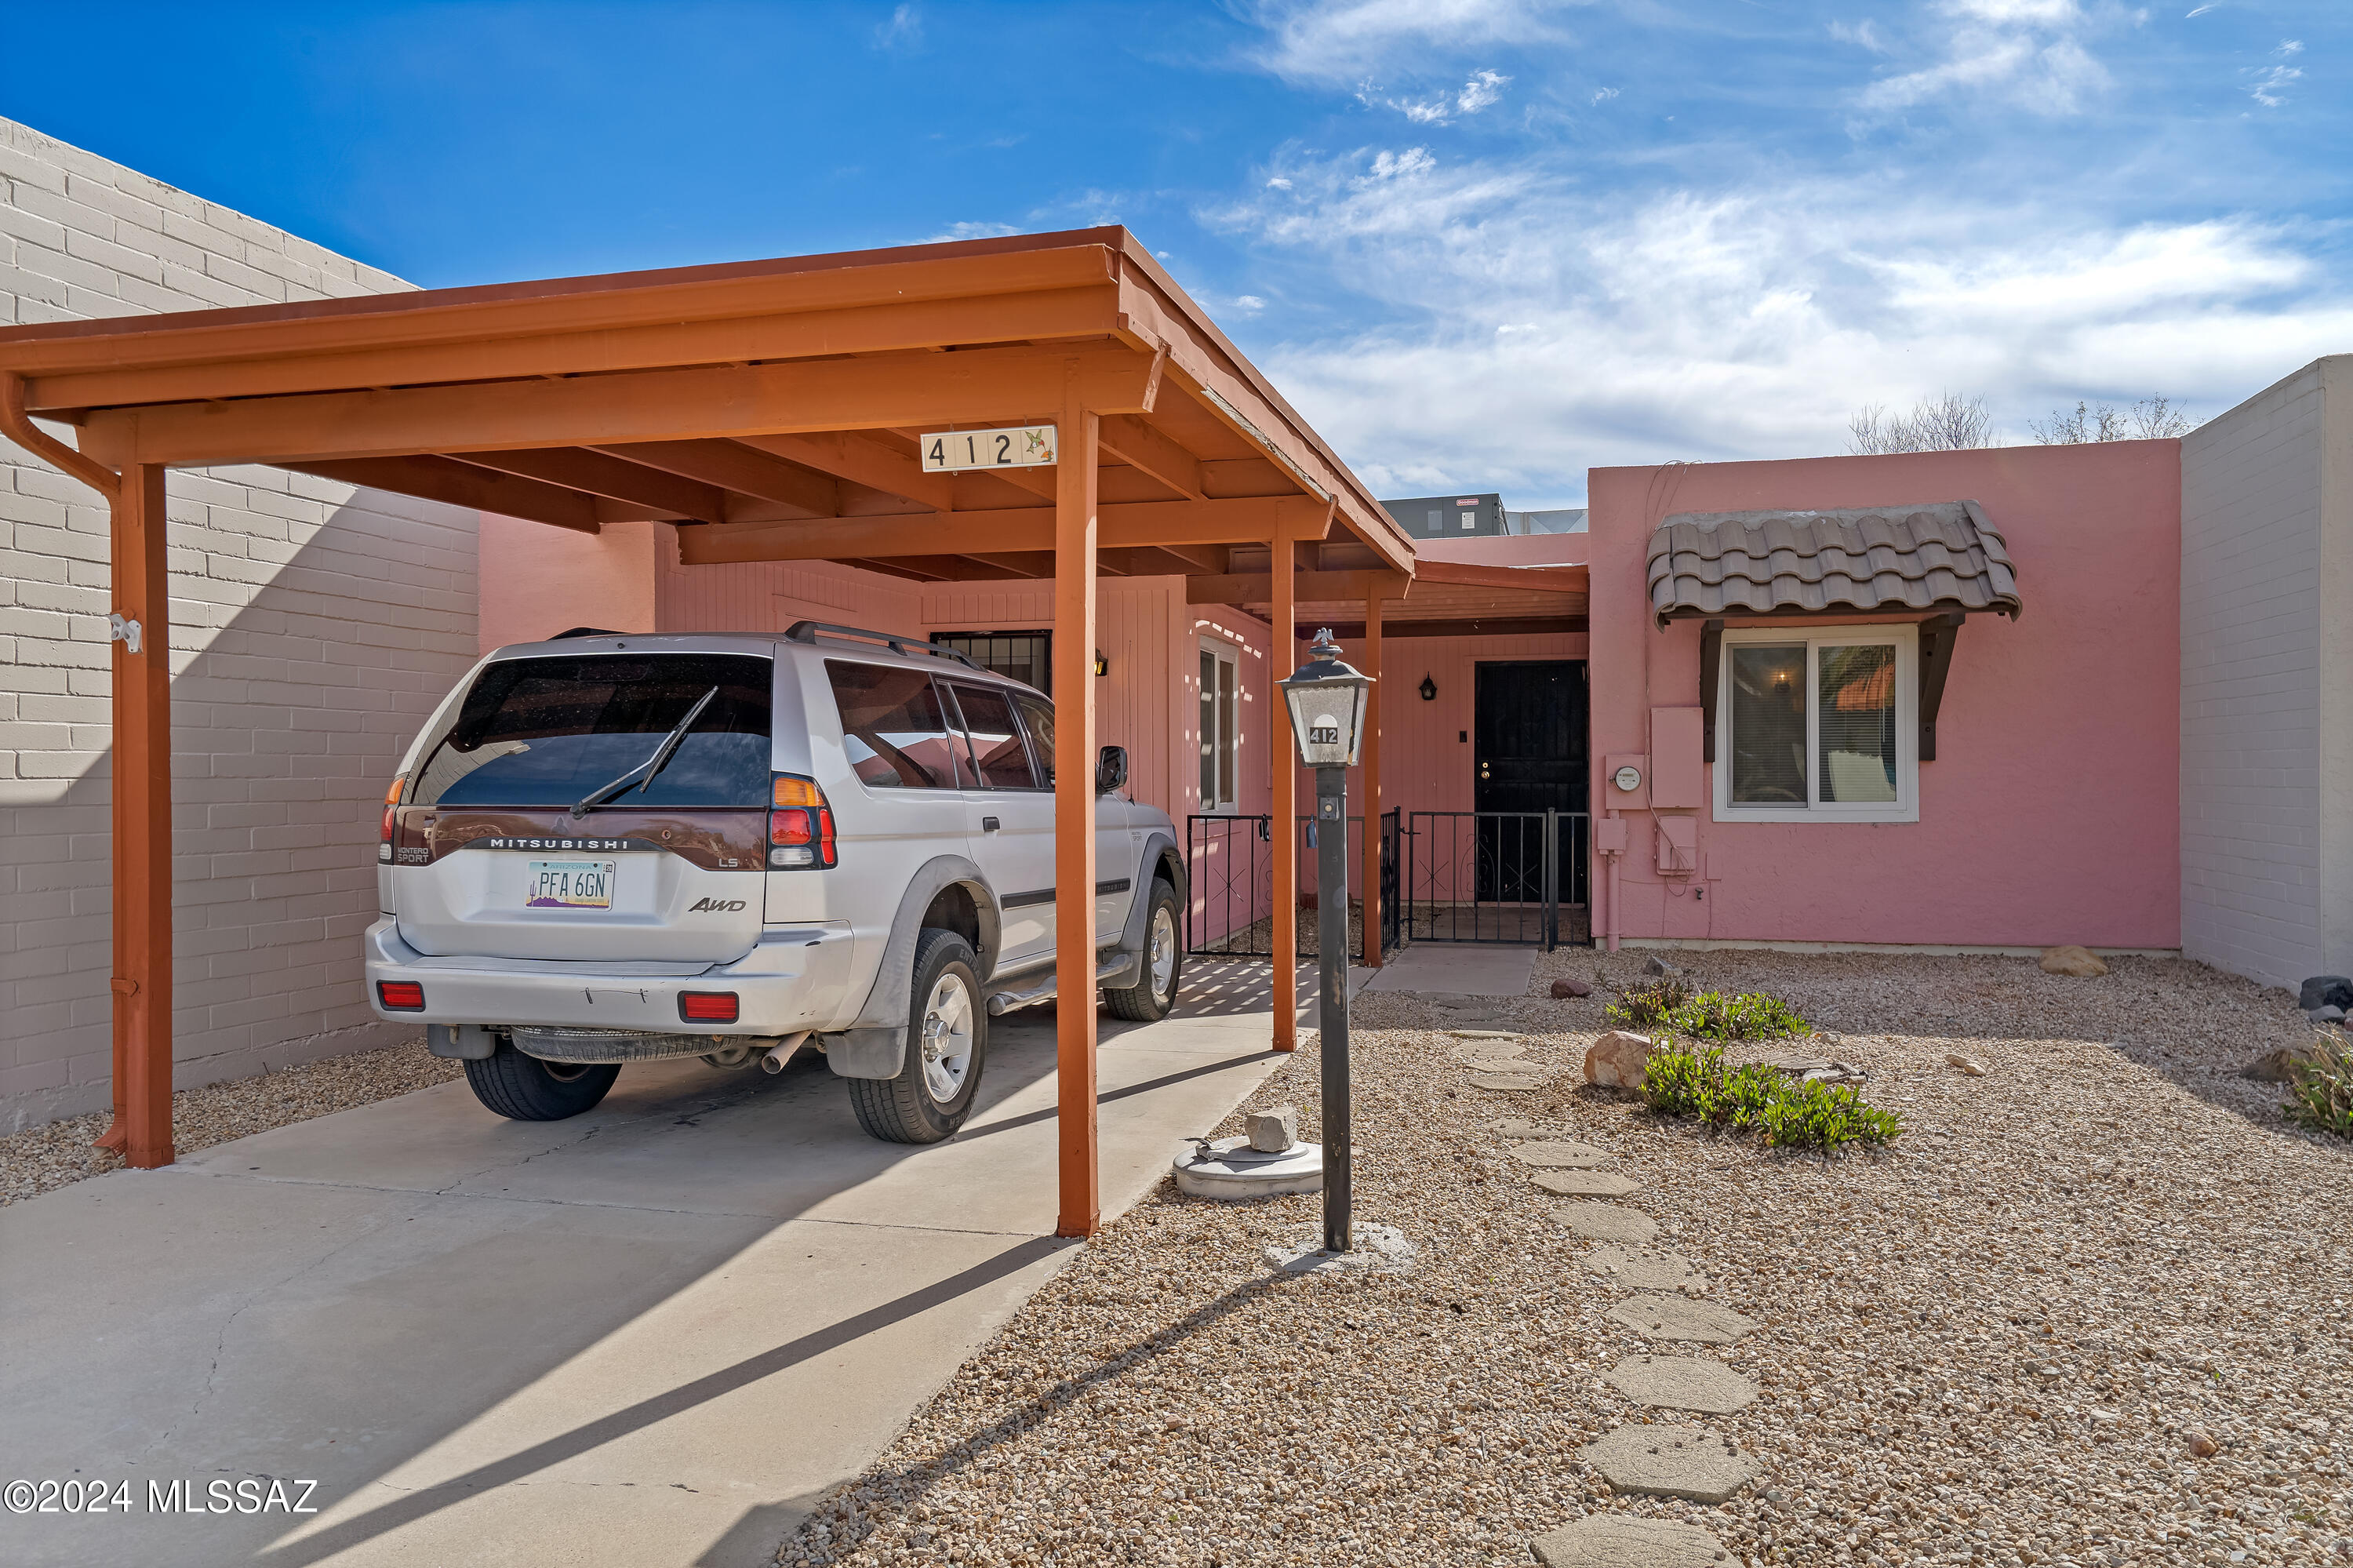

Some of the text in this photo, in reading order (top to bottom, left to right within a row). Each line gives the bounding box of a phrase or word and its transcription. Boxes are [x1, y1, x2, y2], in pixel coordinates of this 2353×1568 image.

[929, 435, 1012, 466] 412
[1310, 729, 1337, 743] 412
[490, 839, 628, 849] MITSUBISHI
[398, 853, 430, 863] SPORT
[718, 858, 738, 868] LS
[539, 871, 606, 897] PFA 6GN
[687, 897, 747, 913] AWD
